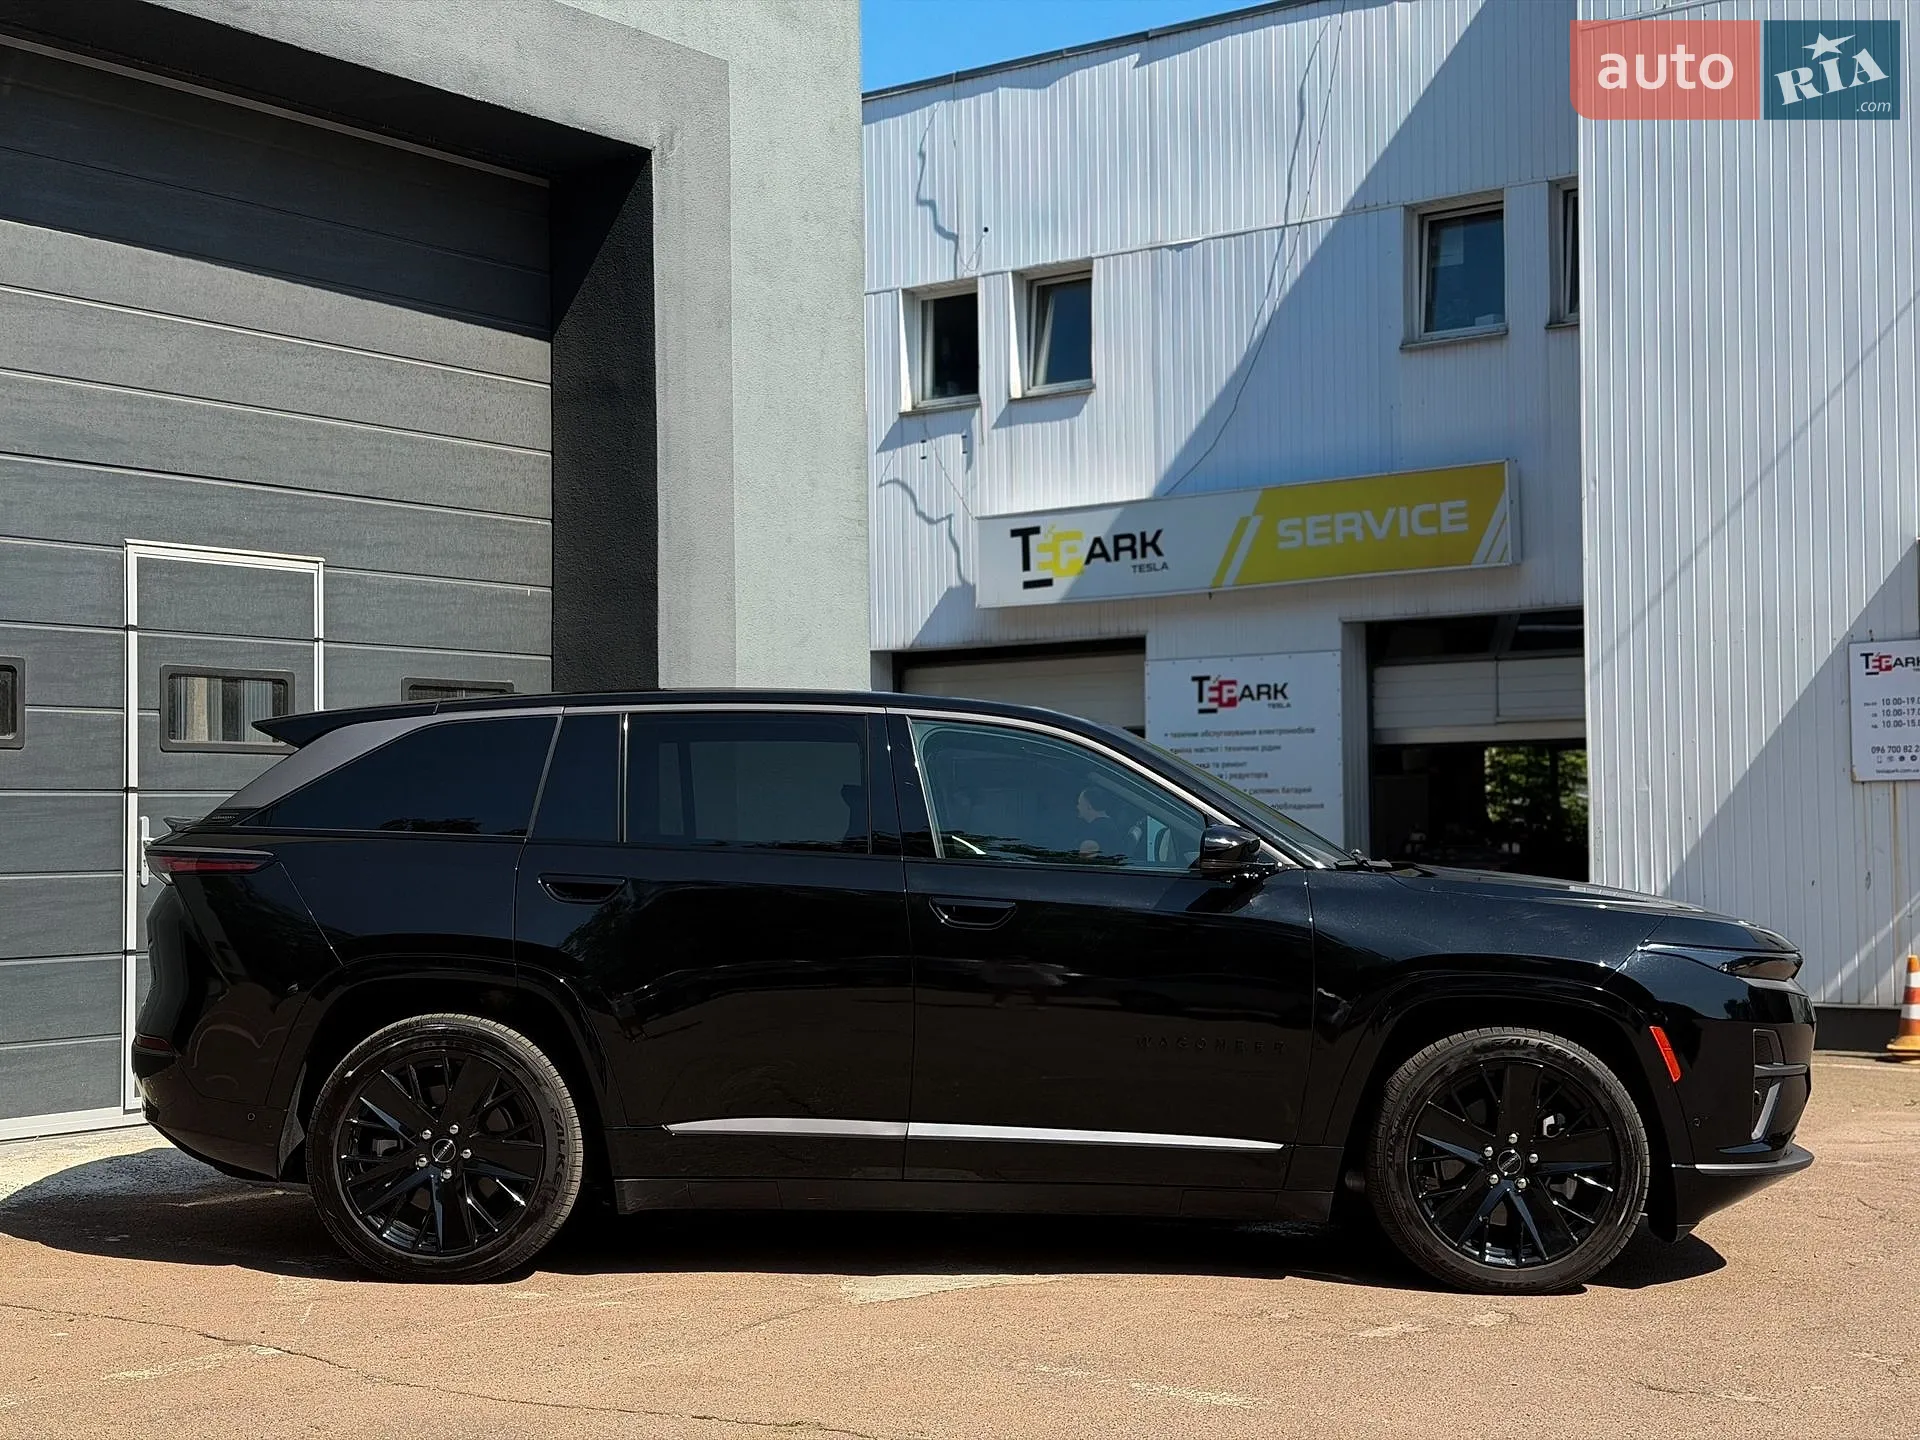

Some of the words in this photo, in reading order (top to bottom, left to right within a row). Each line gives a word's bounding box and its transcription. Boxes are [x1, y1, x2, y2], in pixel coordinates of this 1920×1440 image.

[1276, 499, 1469, 550] SERVICE
[1132, 561, 1170, 574] TESLA
[1871, 746, 1885, 754] 096
[1903, 745, 1912, 753] 82
